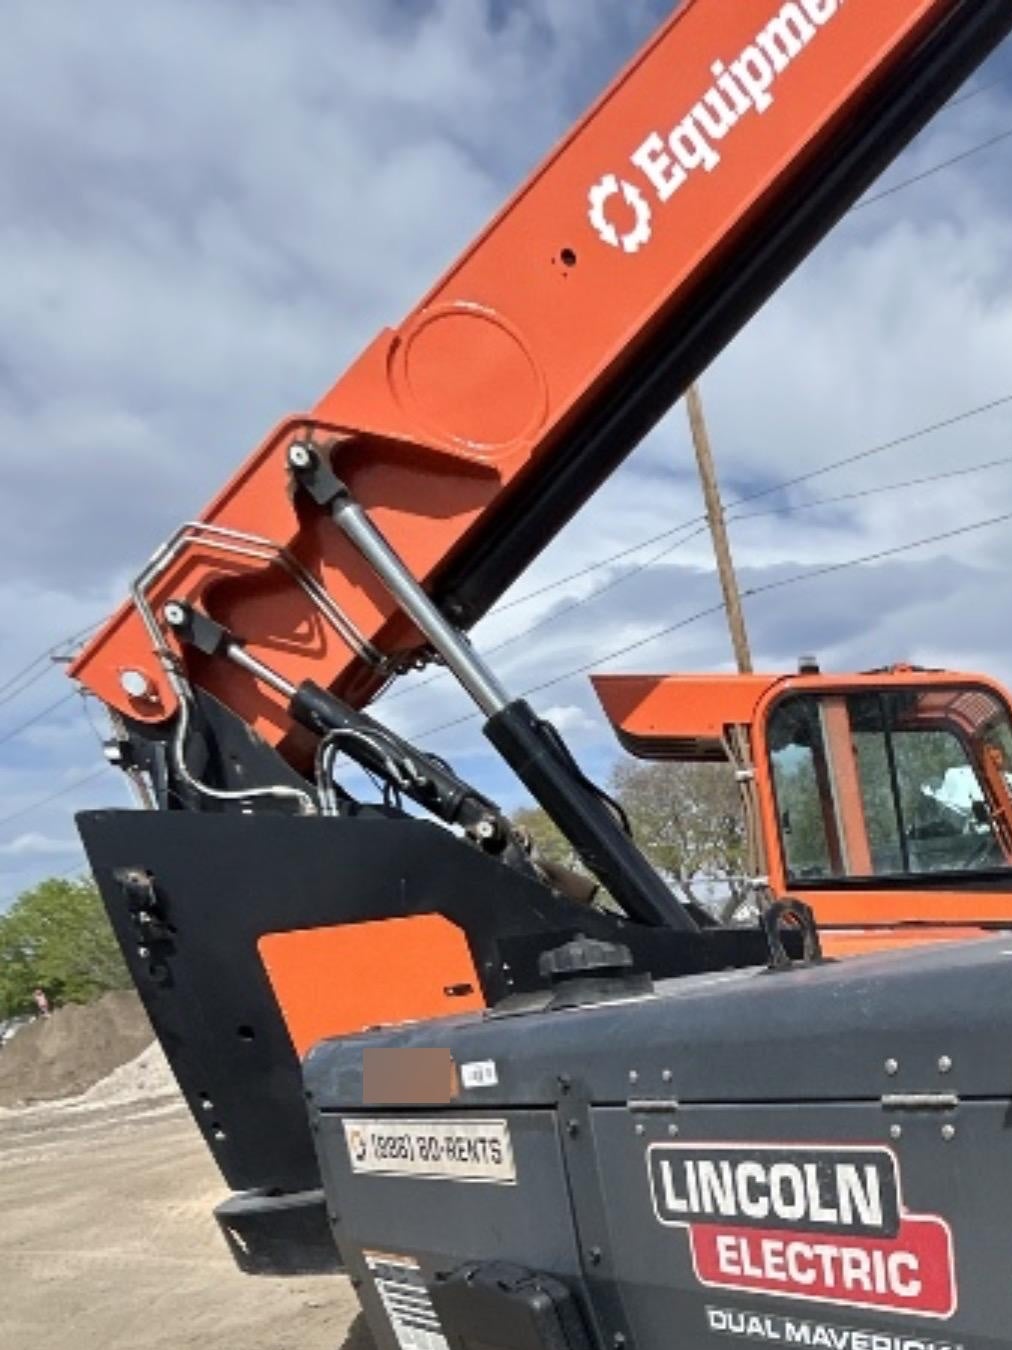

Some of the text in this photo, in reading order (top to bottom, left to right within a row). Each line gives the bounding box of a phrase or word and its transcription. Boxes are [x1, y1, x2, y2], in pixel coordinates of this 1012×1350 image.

[629, 0, 845, 202] Equipme
[659, 1159, 883, 1227] LINCOLN
[715, 1234, 923, 1298] ELECTRIC
[706, 1308, 781, 1340] DUAL
